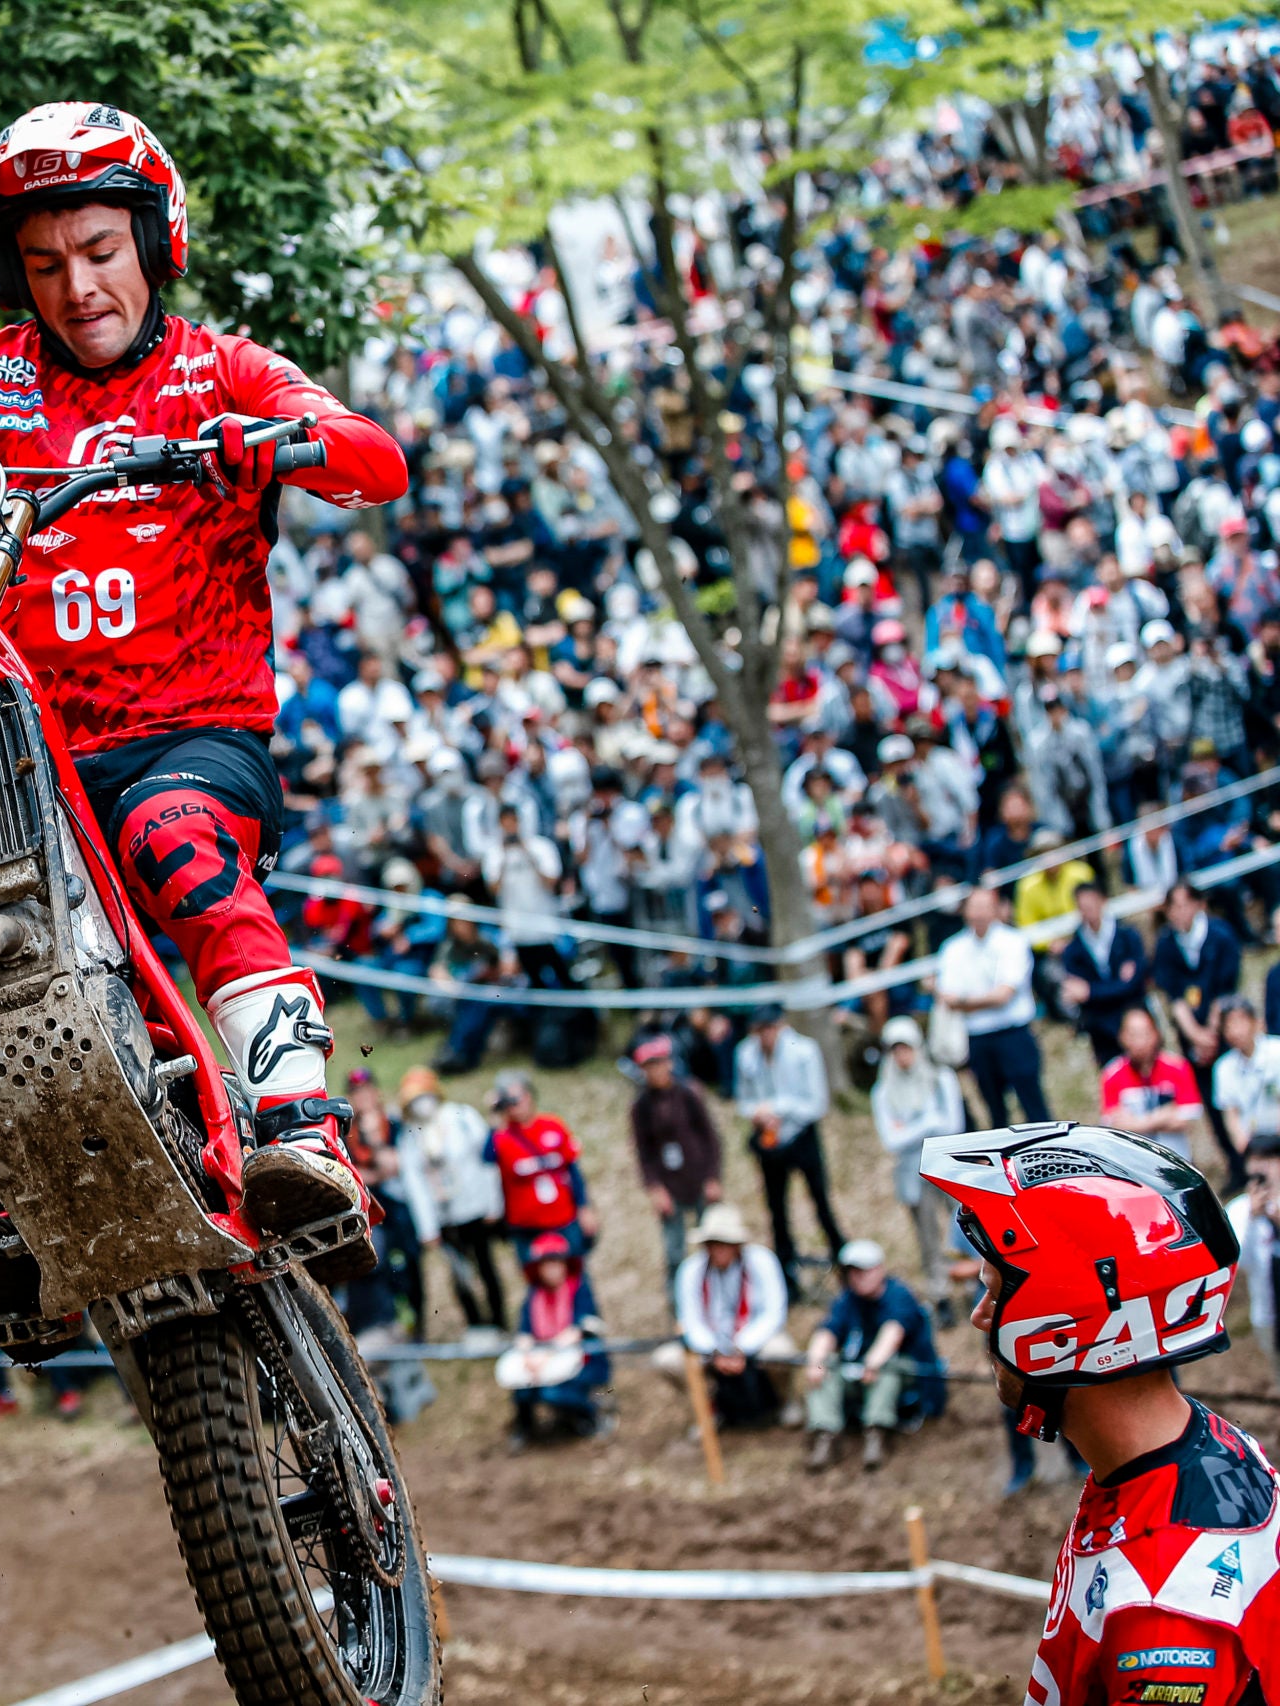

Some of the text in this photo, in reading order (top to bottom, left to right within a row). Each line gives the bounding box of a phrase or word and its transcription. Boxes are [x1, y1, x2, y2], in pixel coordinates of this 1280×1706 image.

[24, 172, 78, 191] GASGAS
[51, 567, 136, 642] 69
[1097, 1355, 1112, 1366] 69
[1140, 1650, 1211, 1667] MOTOREX
